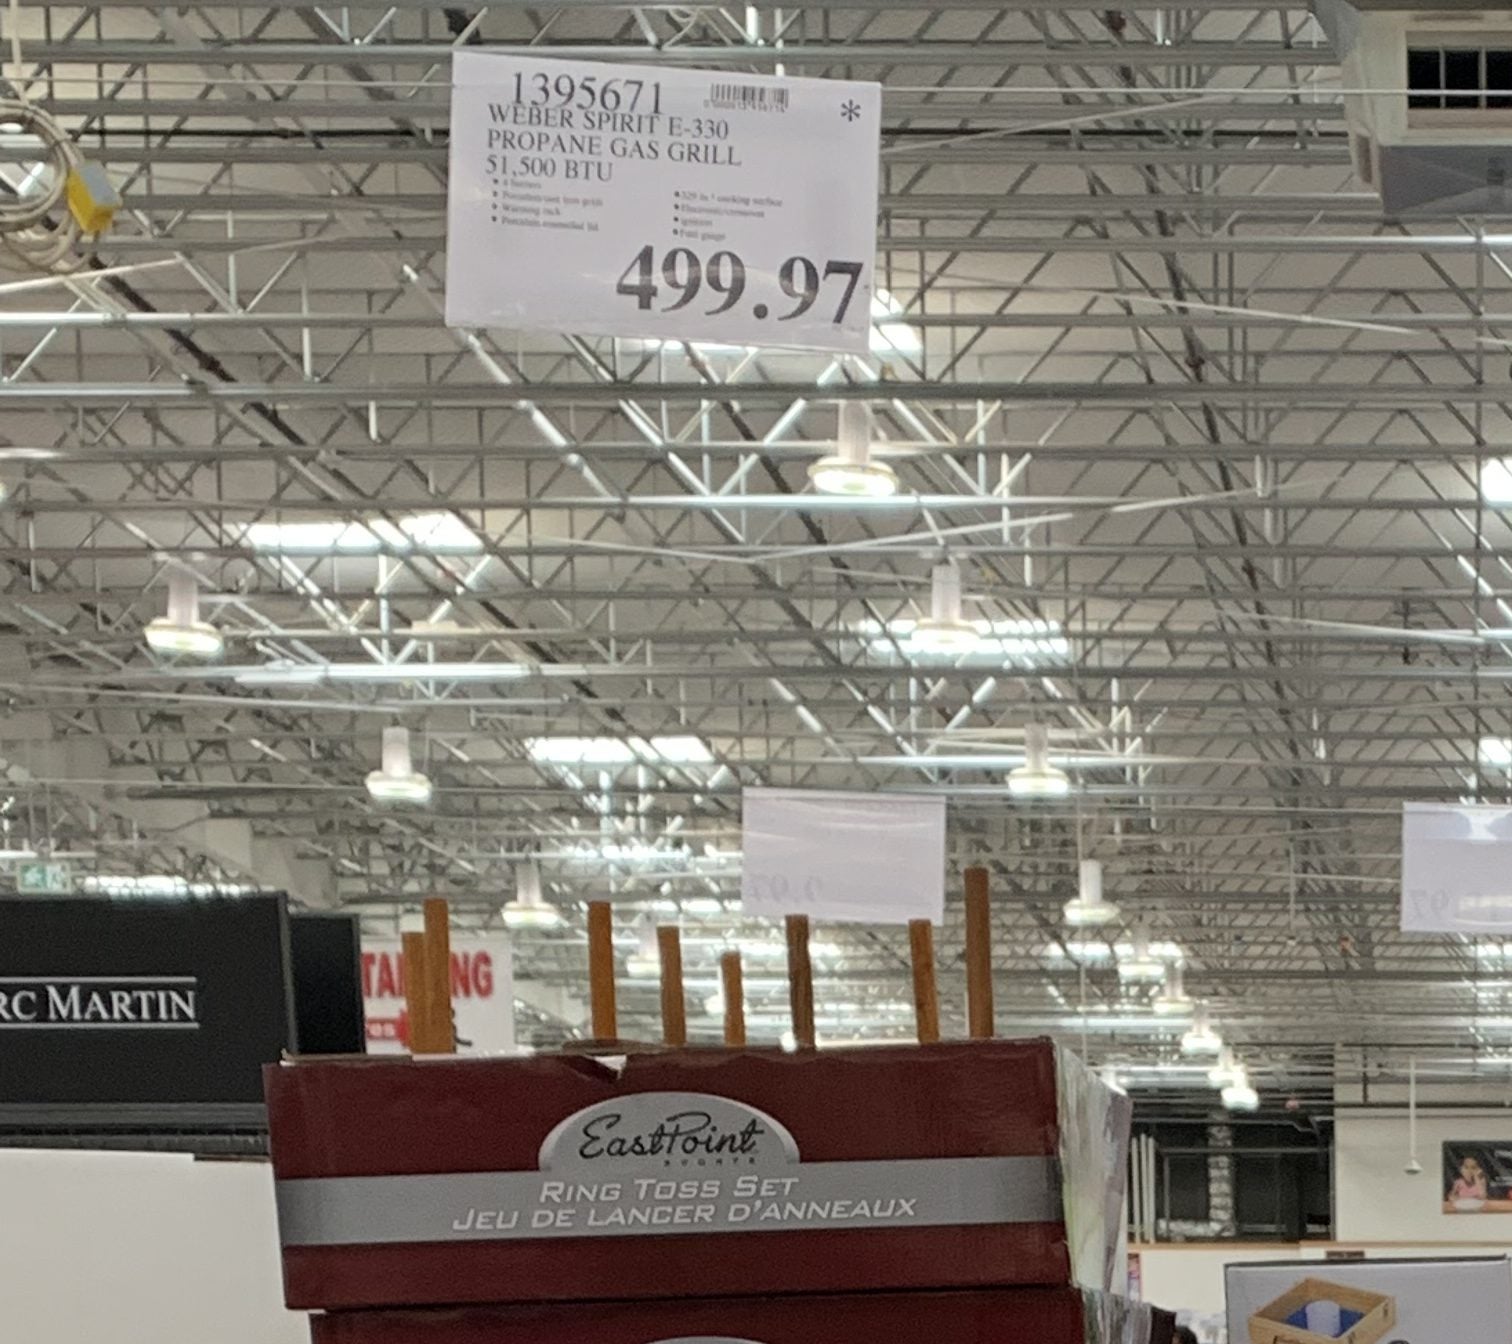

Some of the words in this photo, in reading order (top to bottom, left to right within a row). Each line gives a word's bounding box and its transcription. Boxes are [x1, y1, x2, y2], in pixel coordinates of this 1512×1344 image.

[513, 71, 665, 115] 1395671
[489, 103, 573, 128] WEBER
[582, 109, 661, 135] SPIRIT
[669, 118, 729, 140] E-330
[488, 128, 602, 156] PROPANE
[610, 137, 659, 161] GAS
[668, 142, 742, 166] GRILL
[485, 155, 556, 179] 51,500
[565, 160, 613, 181] BTU
[616, 245, 864, 326] 499.97
[48, 984, 197, 1022] MARTIN
[579, 1110, 764, 1160] EastPoint
[539, 1180, 621, 1203] RING
[634, 1178, 720, 1200] TOSS
[733, 1174, 799, 1197] SET
[452, 1208, 518, 1231] JEU
[531, 1208, 576, 1228] DE
[586, 1204, 713, 1226] LANCER
[728, 1198, 917, 1222] D'ANNEAUX
